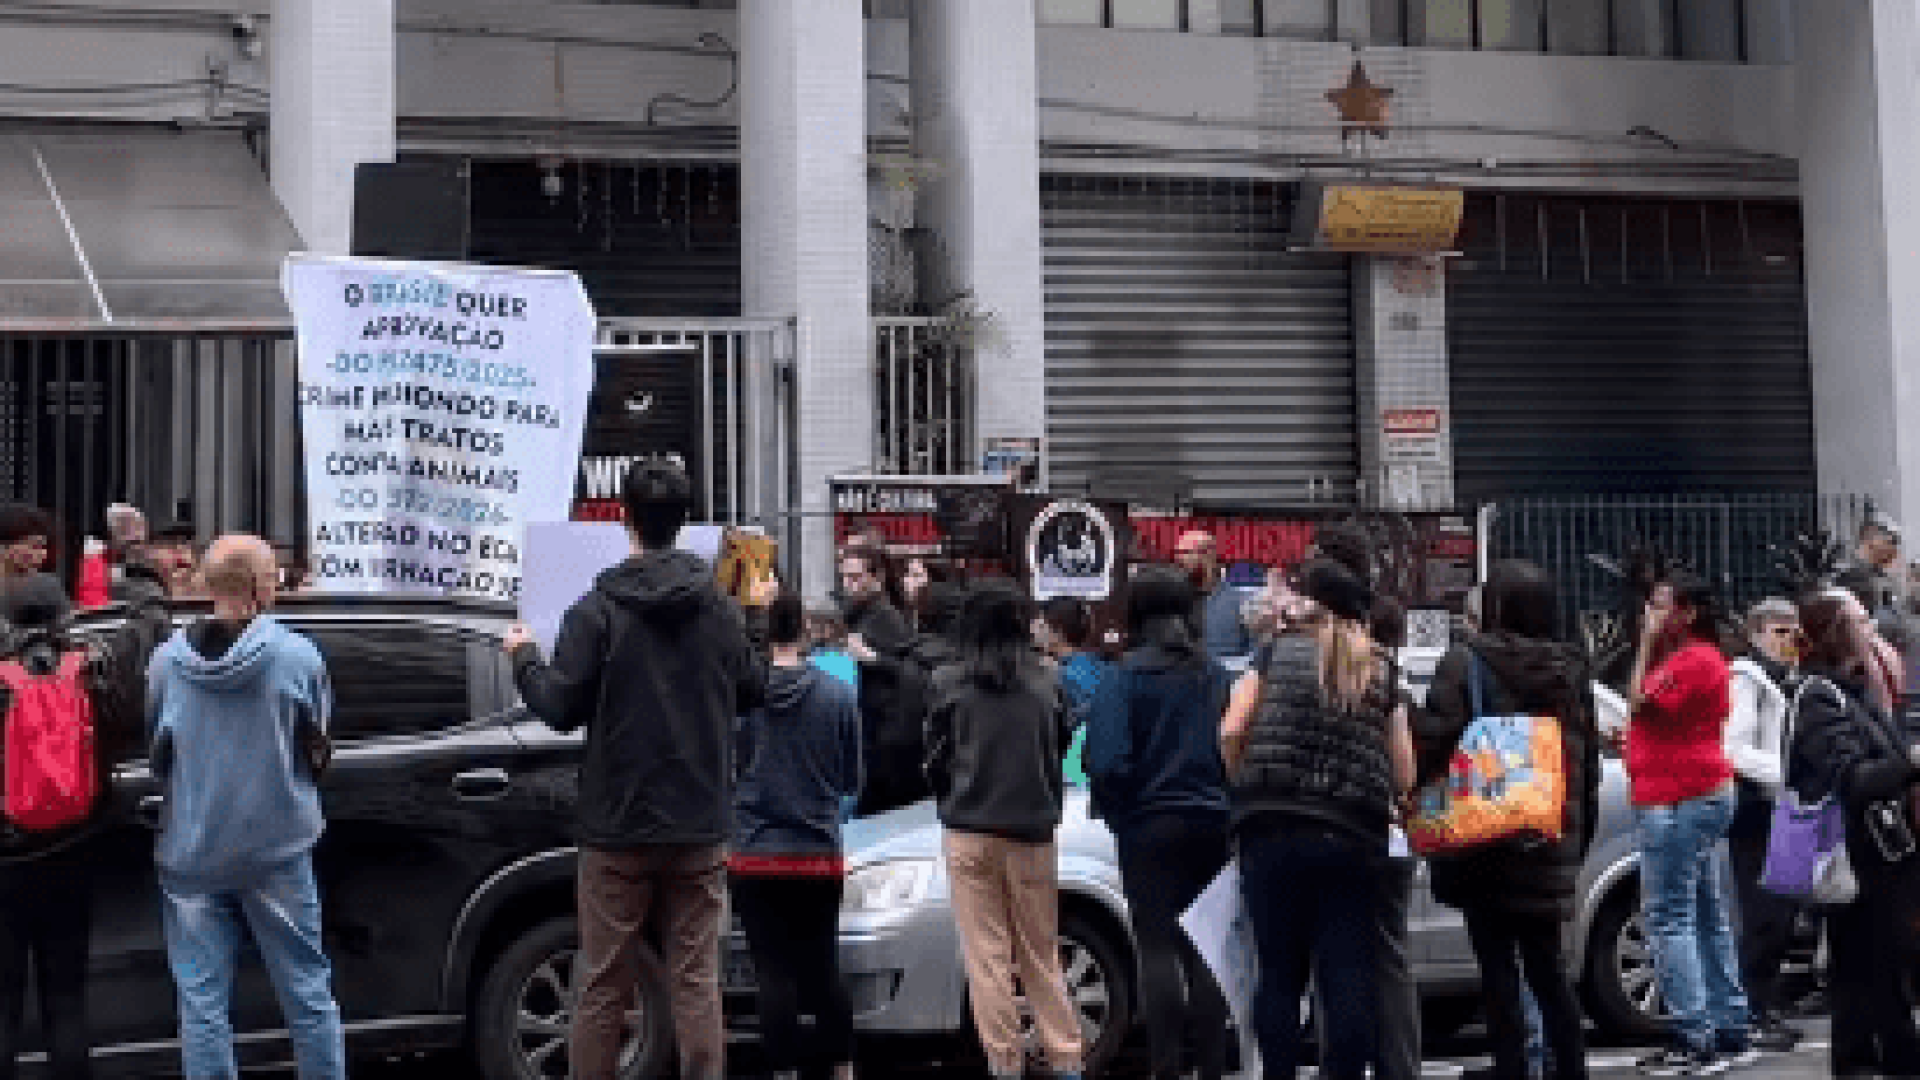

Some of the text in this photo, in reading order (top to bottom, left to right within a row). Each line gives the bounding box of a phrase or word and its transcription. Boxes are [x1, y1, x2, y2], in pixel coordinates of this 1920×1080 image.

[344, 283, 363, 307] O
[456, 292, 527, 318] QUER
[401, 418, 504, 456] TRATOS
[409, 455, 518, 492] ANIMAIS
[428, 529, 471, 555] NO
